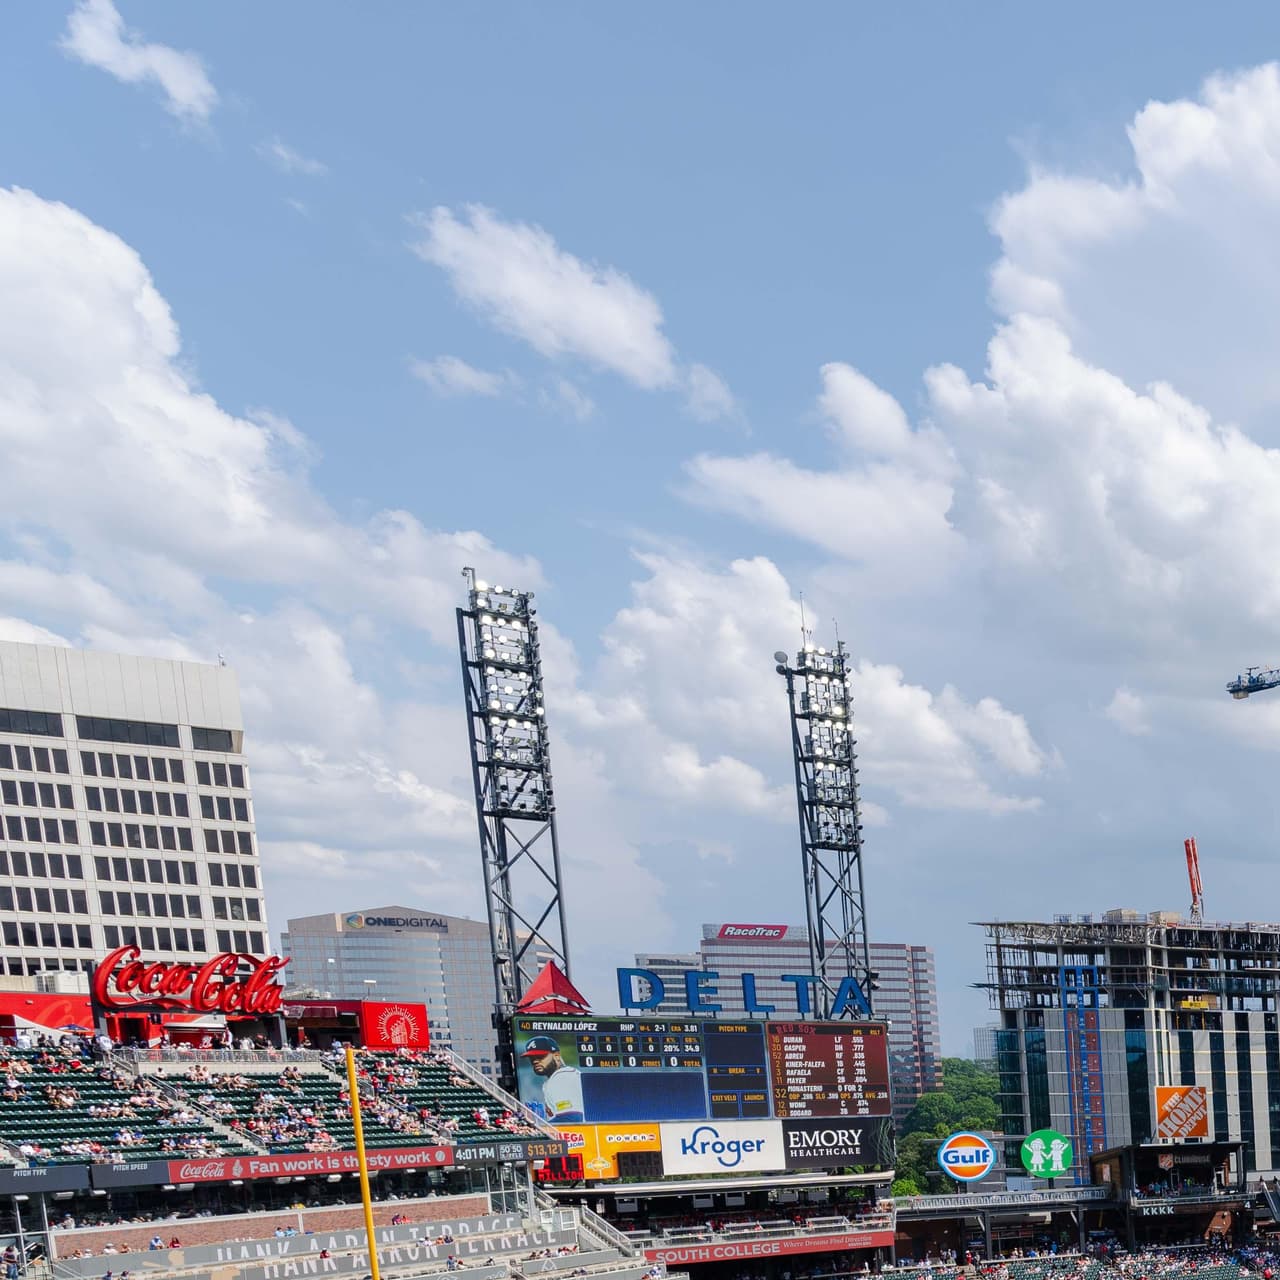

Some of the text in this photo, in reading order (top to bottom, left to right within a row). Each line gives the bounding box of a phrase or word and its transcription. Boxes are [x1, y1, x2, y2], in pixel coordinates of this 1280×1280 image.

[365, 914, 448, 929] ONEDIGITAL
[725, 926, 780, 938] RaceTrac
[617, 968, 873, 1015] DELTA
[532, 1022, 573, 1031] REYNALDO
[1162, 1091, 1183, 1112] THE
[1158, 1086, 1207, 1138] HOME
[1178, 1104, 1209, 1138] DEPOT
[681, 1126, 765, 1167] Kroger
[788, 1129, 864, 1148] EMORY
[456, 1148, 480, 1161] 4:01
[481, 1147, 495, 1159] PM
[527, 1143, 564, 1157] $13,121
[790, 1148, 861, 1158] HEALTHCARE
[943, 1149, 991, 1165] Gulf
[249, 1151, 431, 1175] Fan work is thrsty work
[655, 1242, 781, 1263] SOUTH COLLEGE
